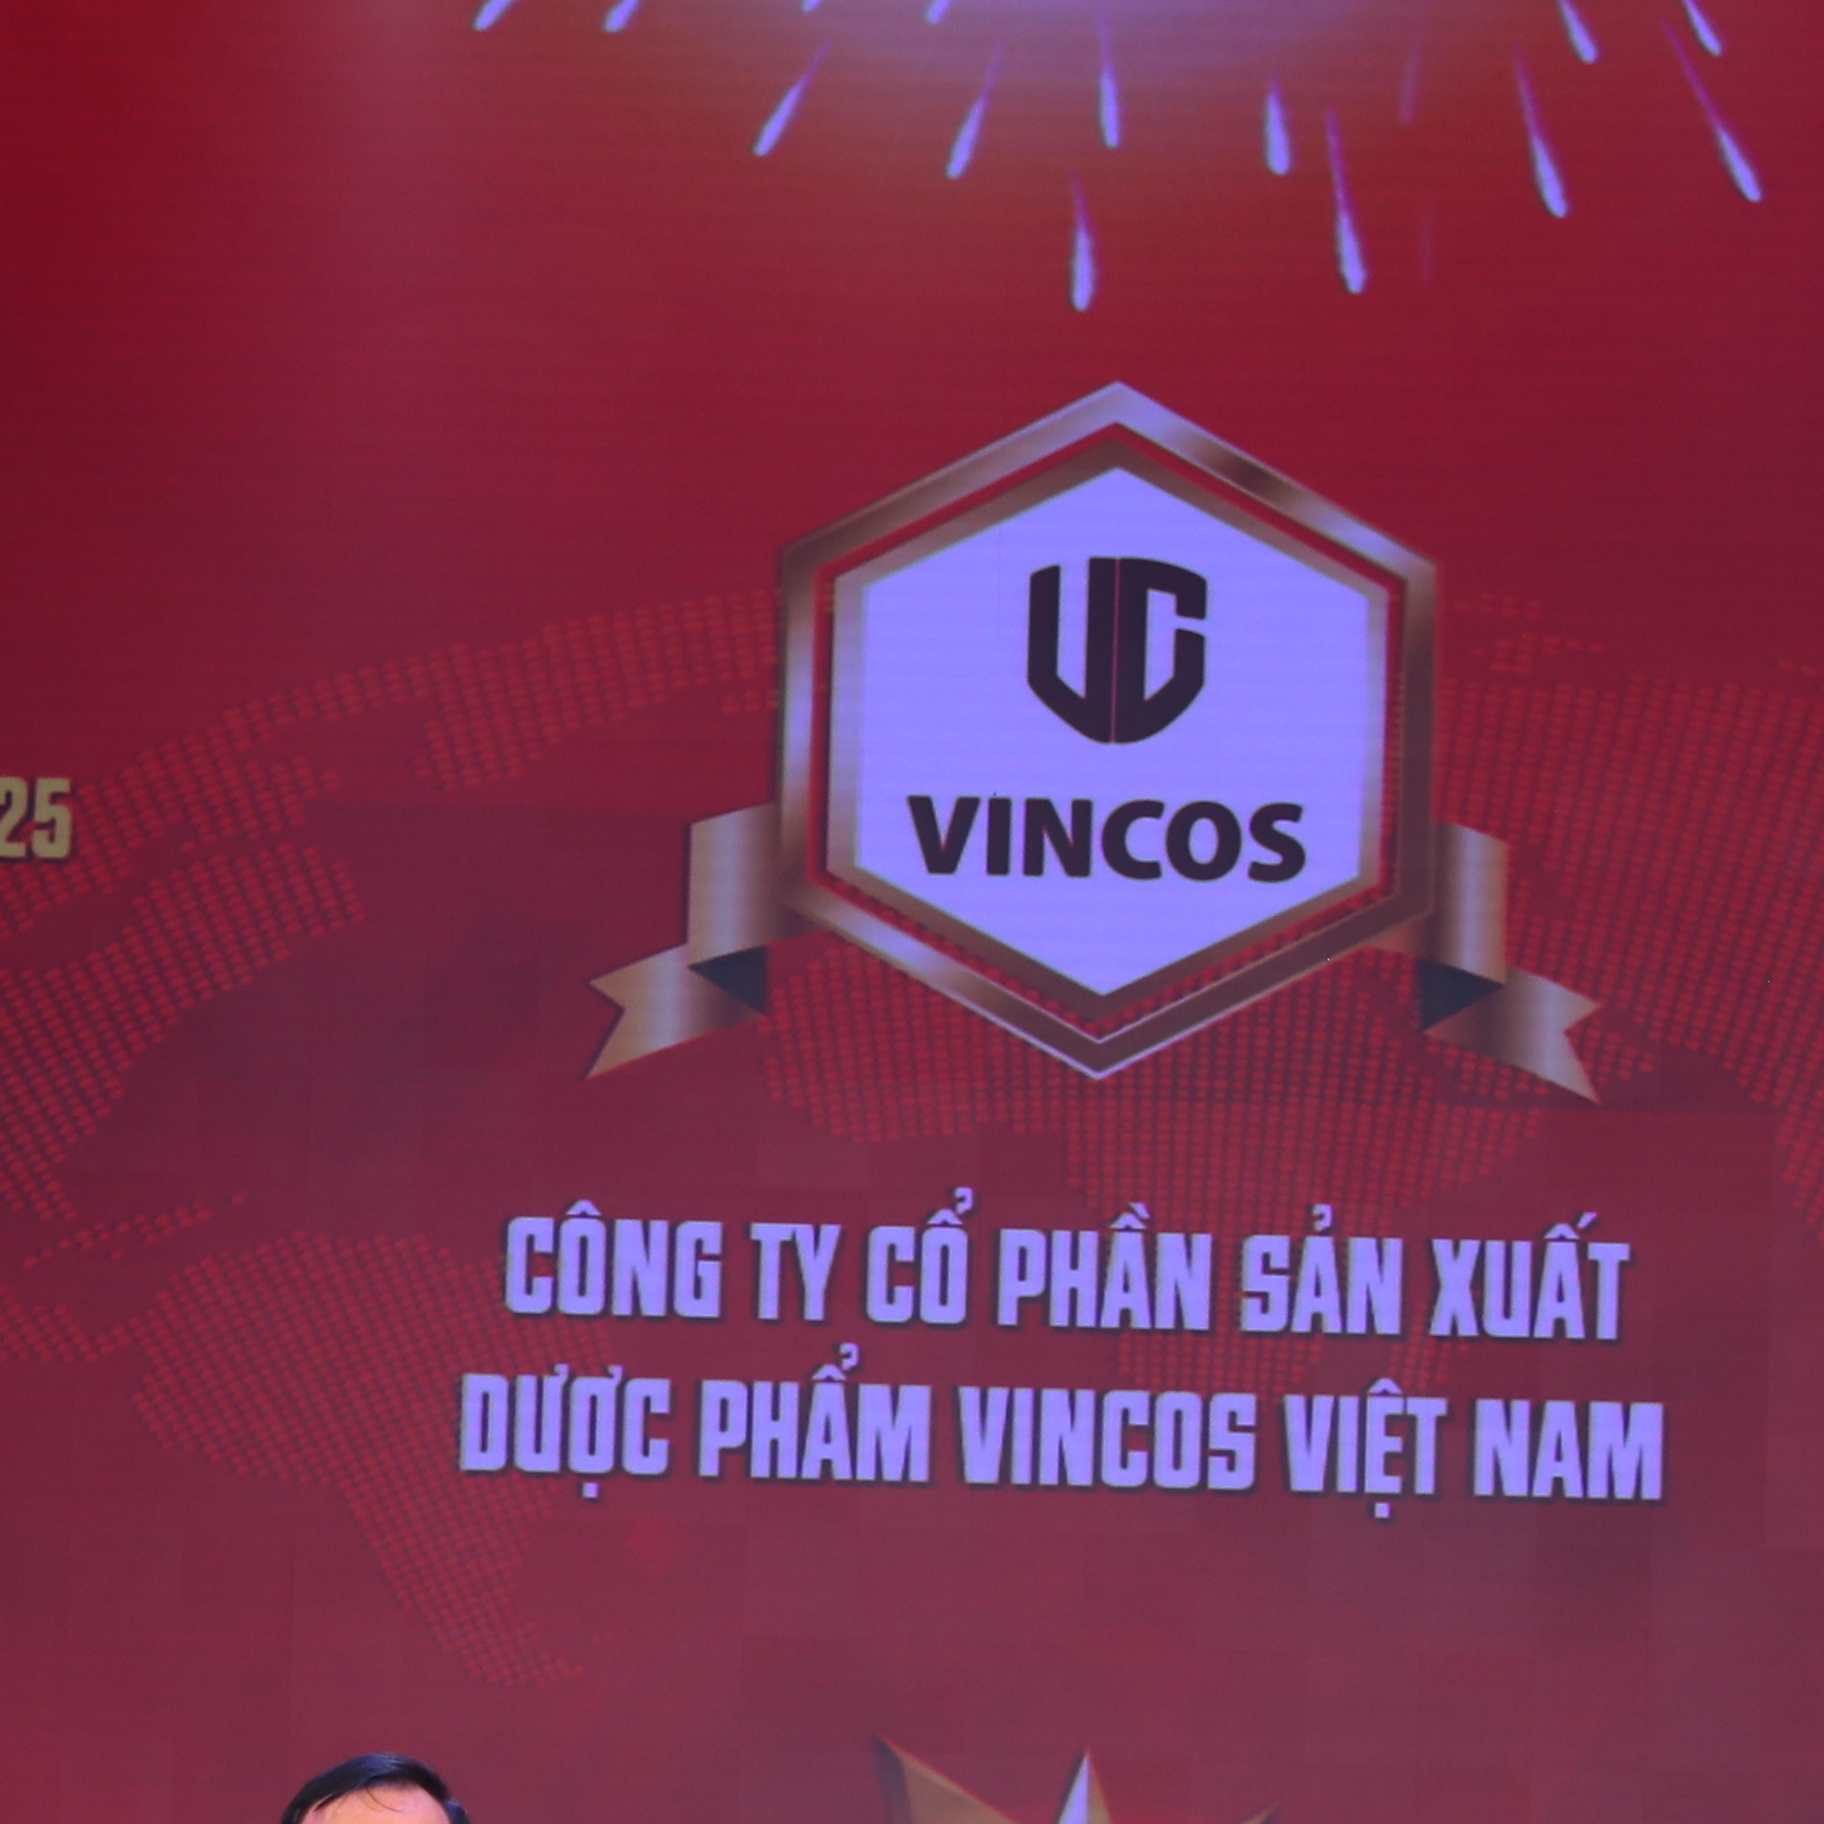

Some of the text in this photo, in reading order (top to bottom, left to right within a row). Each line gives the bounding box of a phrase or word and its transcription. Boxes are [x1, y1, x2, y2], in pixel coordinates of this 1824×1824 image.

[907, 795, 1306, 883] VINCOS
[505, 1187, 1631, 1341] CÔNG TY CỔ PHẦN SẢN XUẤT
[459, 1342, 1665, 1519] DƯỢC PHẨM VINCOS VIỆT NAM
